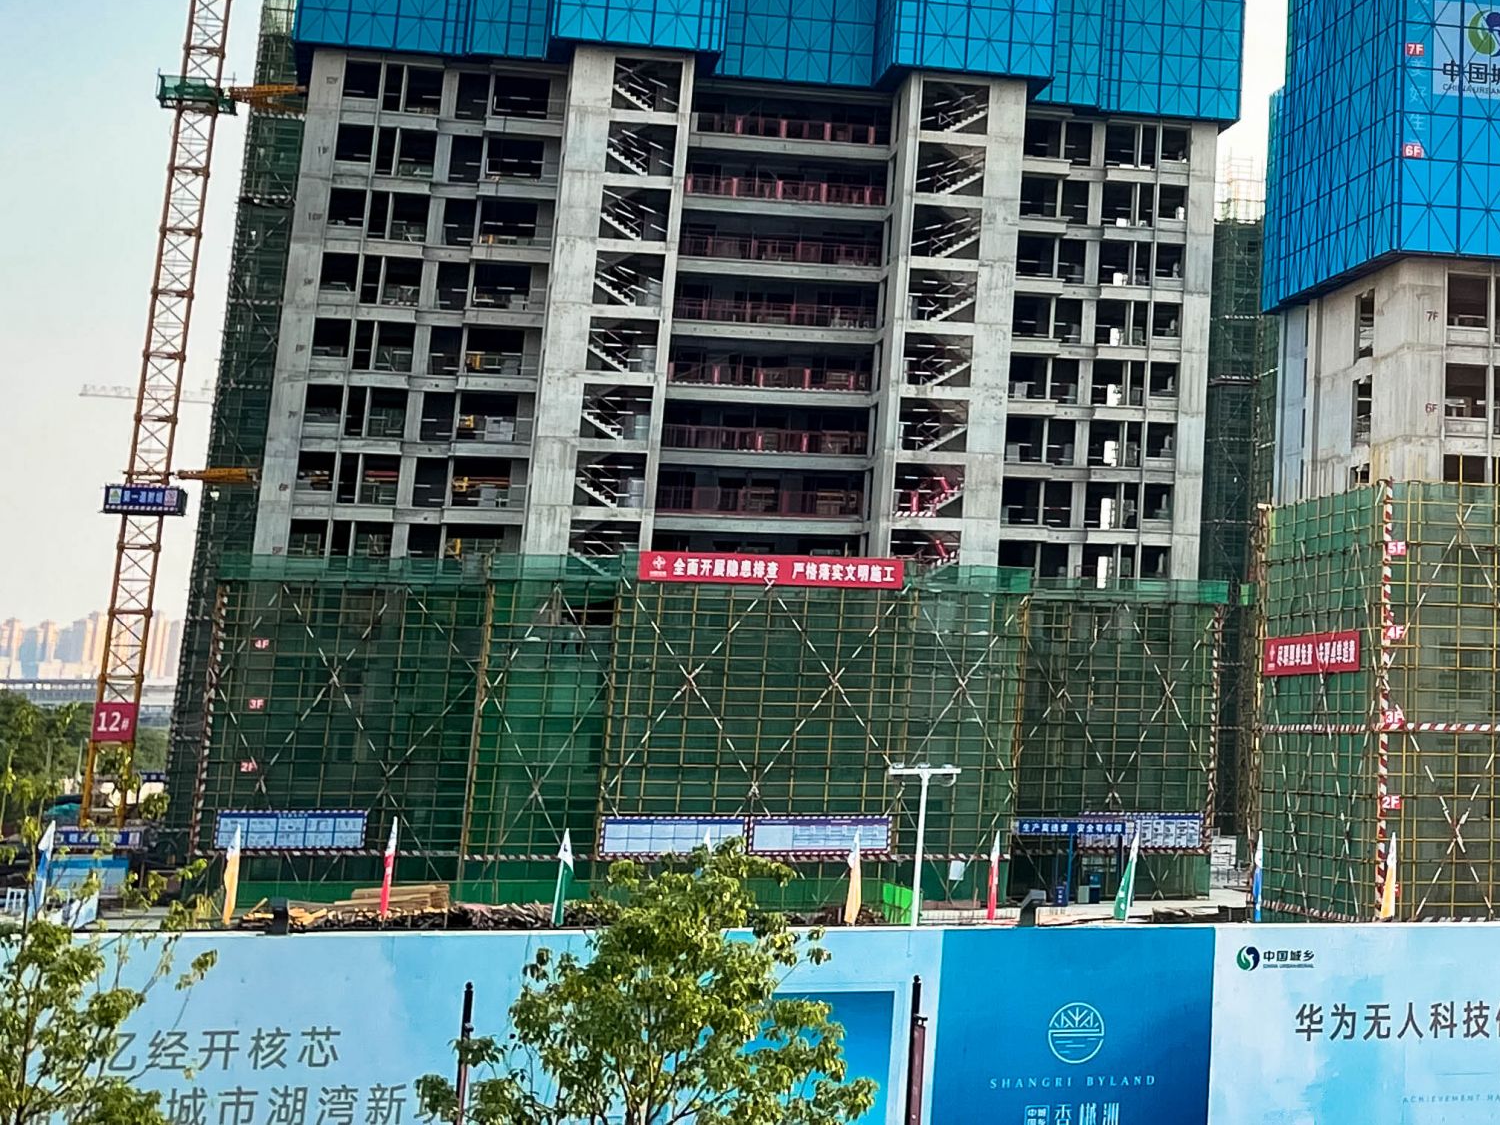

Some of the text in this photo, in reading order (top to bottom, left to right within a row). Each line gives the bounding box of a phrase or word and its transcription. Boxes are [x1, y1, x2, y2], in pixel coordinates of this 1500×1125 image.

[1407, 44, 1424, 55] 7F
[1405, 146, 1421, 157] 6F
[1426, 311, 1439, 322] 7F
[1425, 403, 1438, 414] 6F
[1388, 542, 1405, 554] 5F
[792, 562, 896, 583] 严格落实文明施工
[1387, 627, 1404, 640] 4F
[255, 639, 269, 649] 4F
[249, 699, 264, 709] 3F
[97, 711, 129, 732] 12#
[1386, 711, 1404, 723] 3F
[240, 762, 255, 772] 2F
[1382, 796, 1400, 809] 2F
[1263, 950, 1315, 962] 中国城乡
[989, 1075, 1156, 1089] SHANGRI BYLAND
